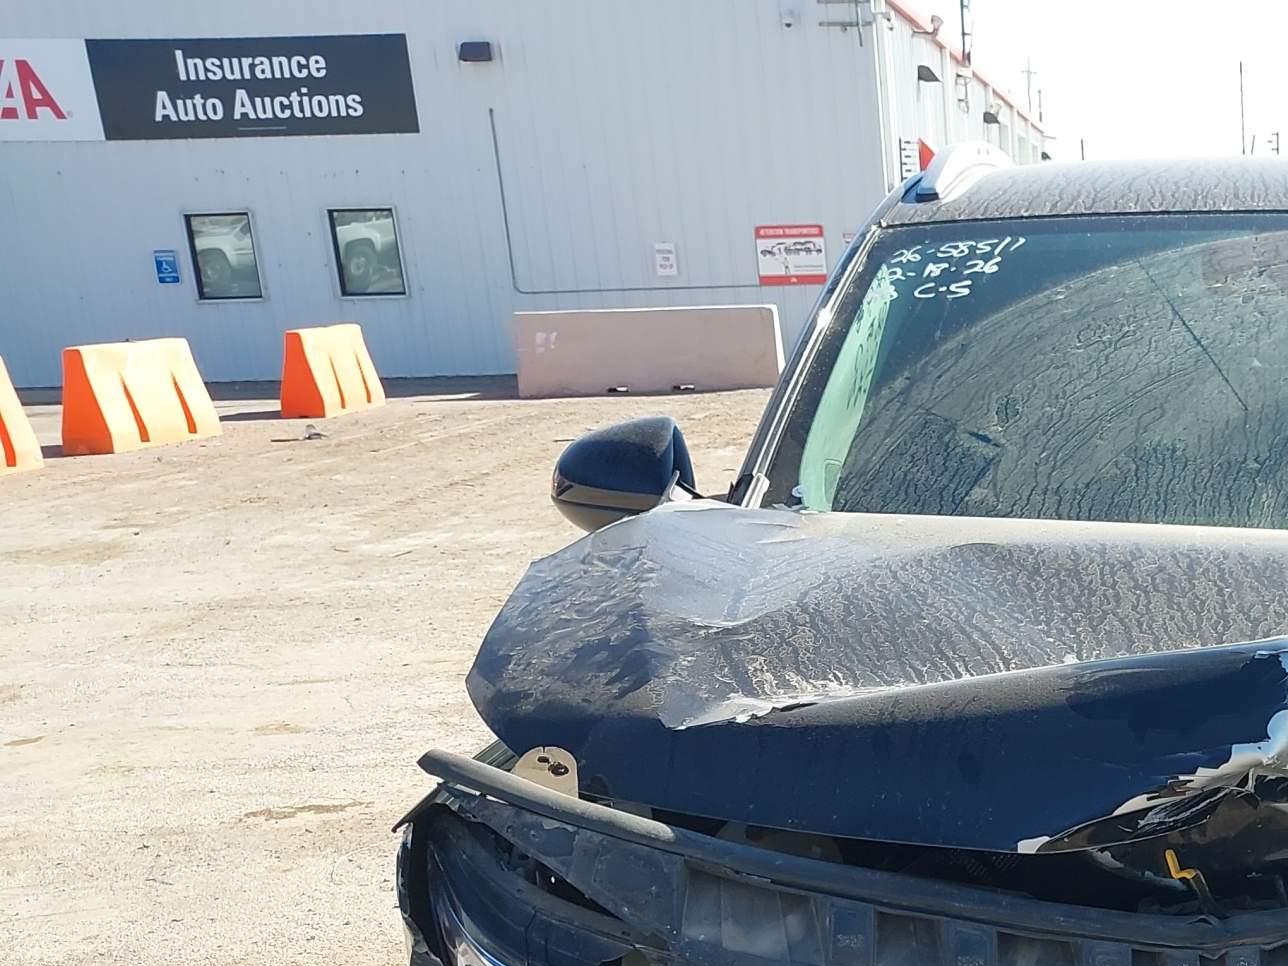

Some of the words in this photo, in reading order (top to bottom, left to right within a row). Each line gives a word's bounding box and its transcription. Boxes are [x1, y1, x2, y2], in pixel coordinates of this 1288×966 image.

[174, 49, 327, 81] Insurance
[154, 90, 223, 122] Auto
[233, 87, 364, 120] Auctions
